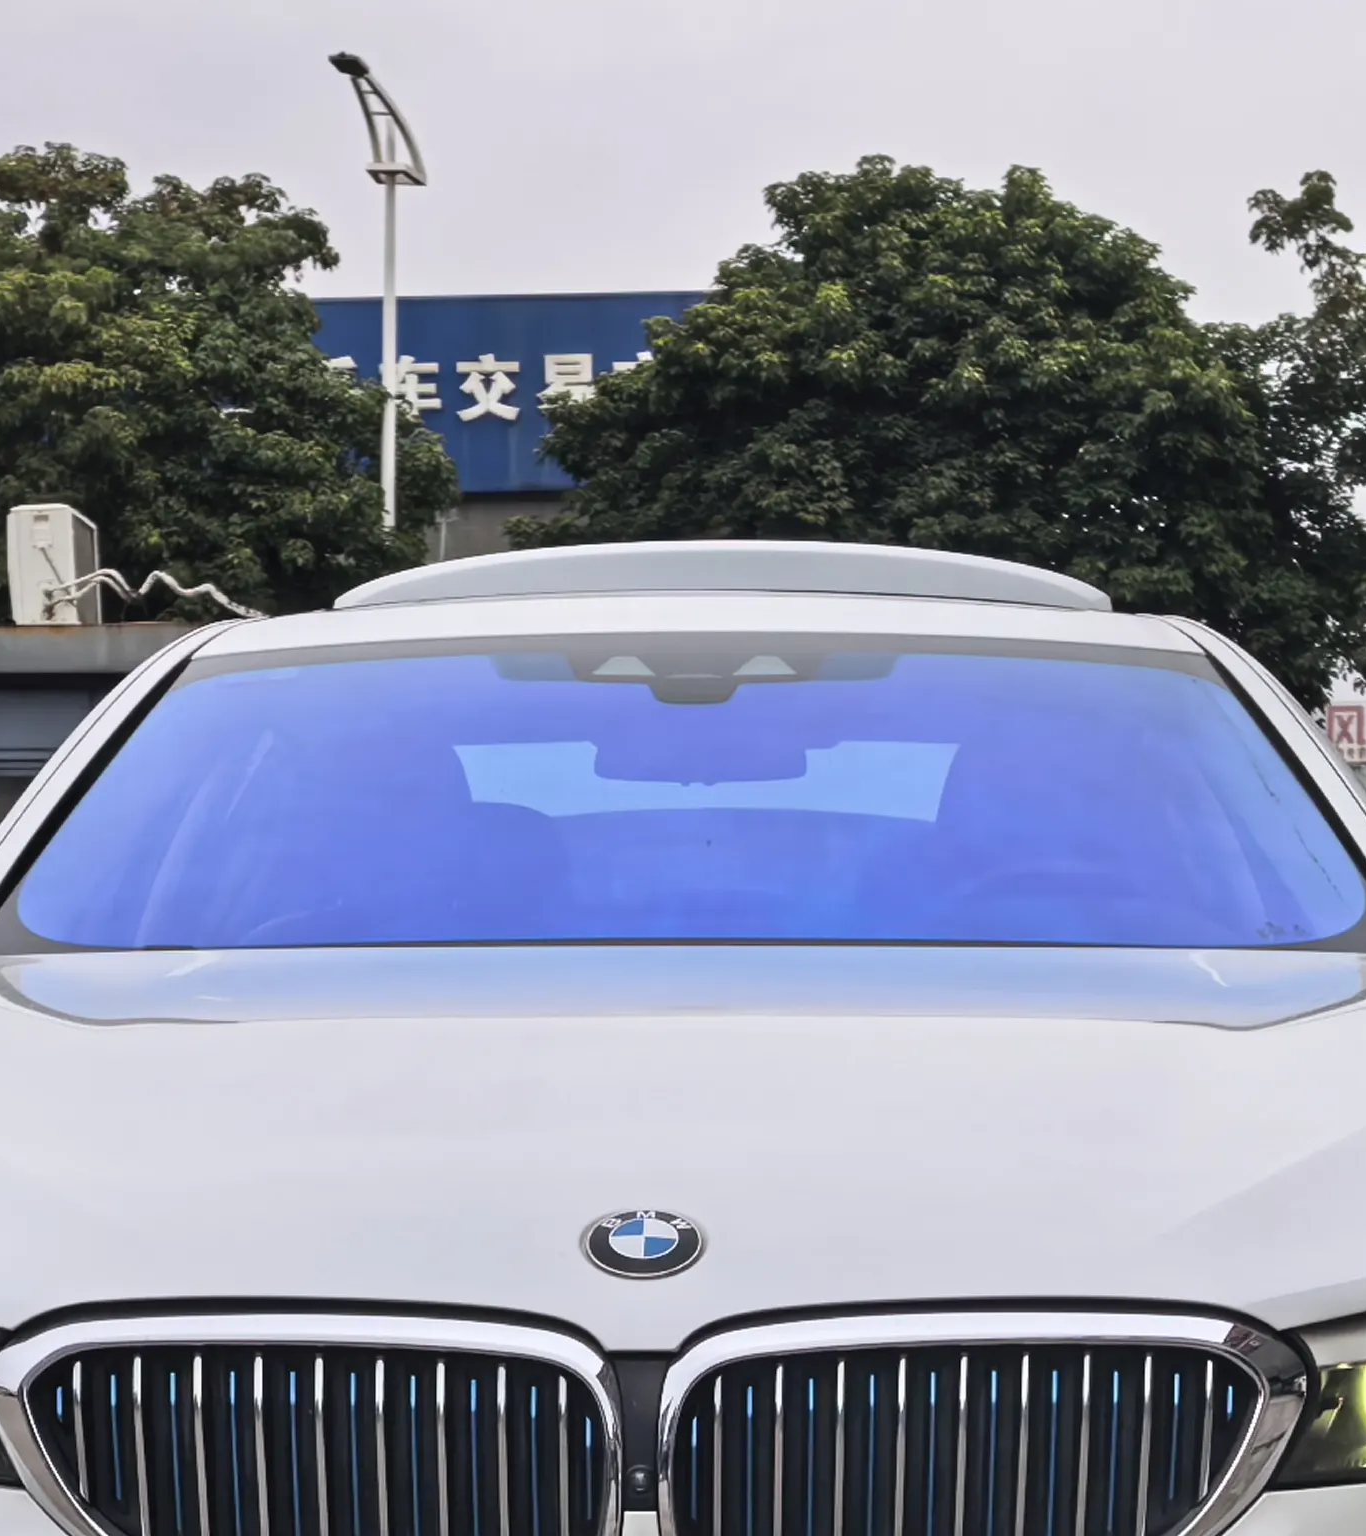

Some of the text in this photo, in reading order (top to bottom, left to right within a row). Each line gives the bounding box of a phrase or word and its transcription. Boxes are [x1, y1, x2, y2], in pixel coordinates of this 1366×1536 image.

[325, 353, 653, 422] 车交易
[601, 1211, 692, 1230] BMW
